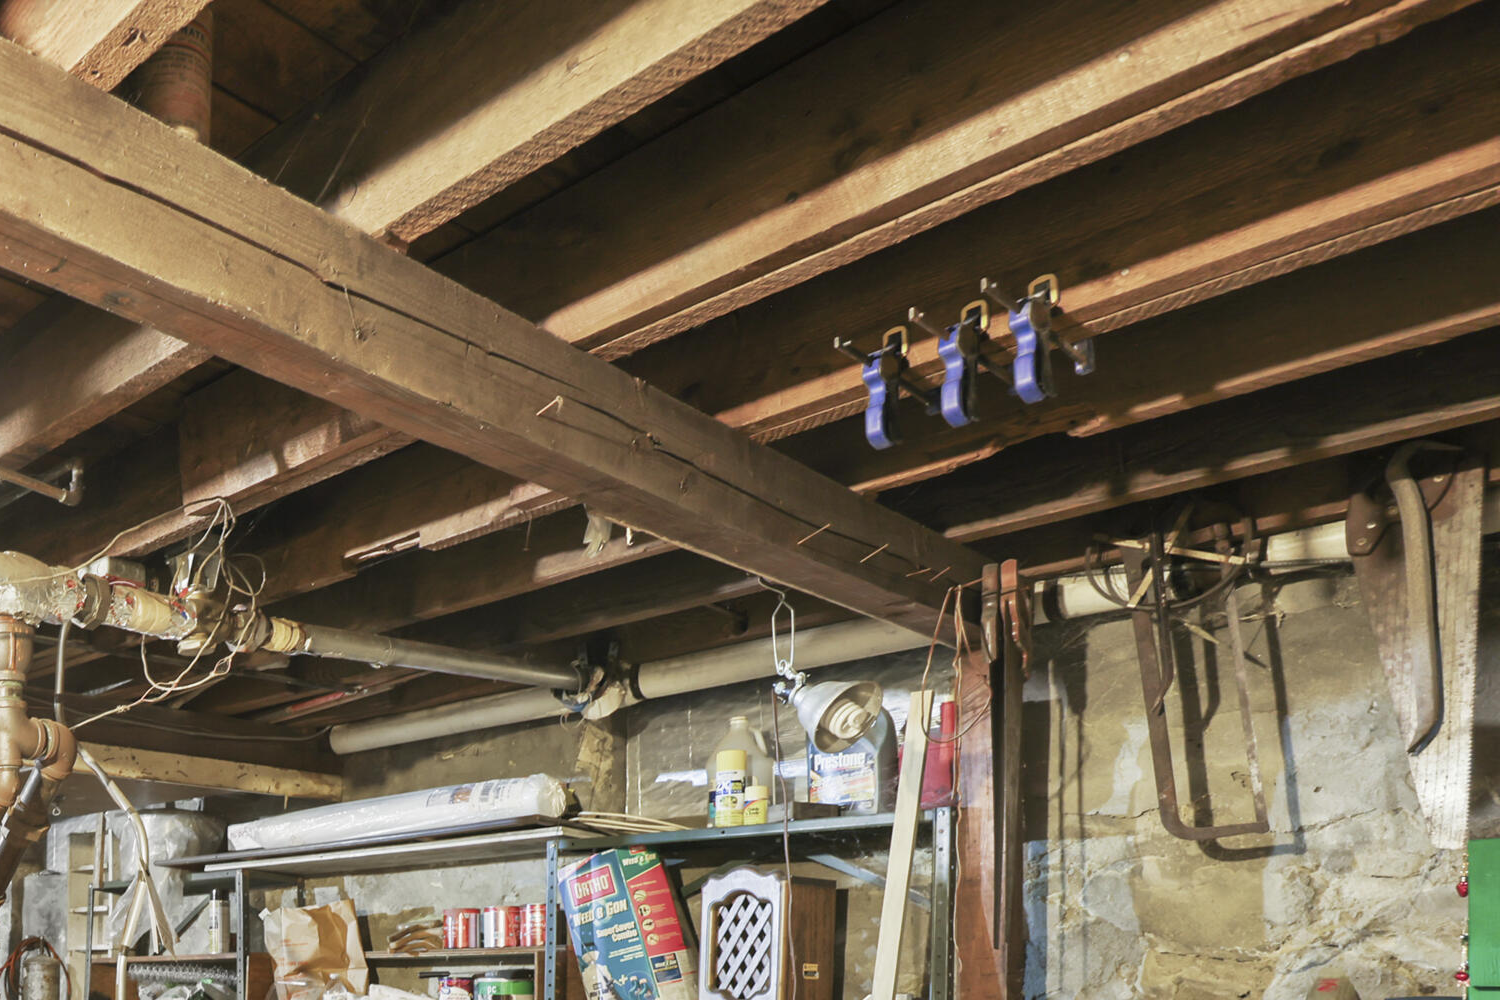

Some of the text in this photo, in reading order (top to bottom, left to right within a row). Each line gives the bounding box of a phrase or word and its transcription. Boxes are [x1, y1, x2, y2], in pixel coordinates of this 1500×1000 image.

[814, 752, 866, 772] Prestone
[574, 874, 609, 899] ORTHO
[572, 909, 595, 927] WEED
[606, 899, 629, 917] GON
